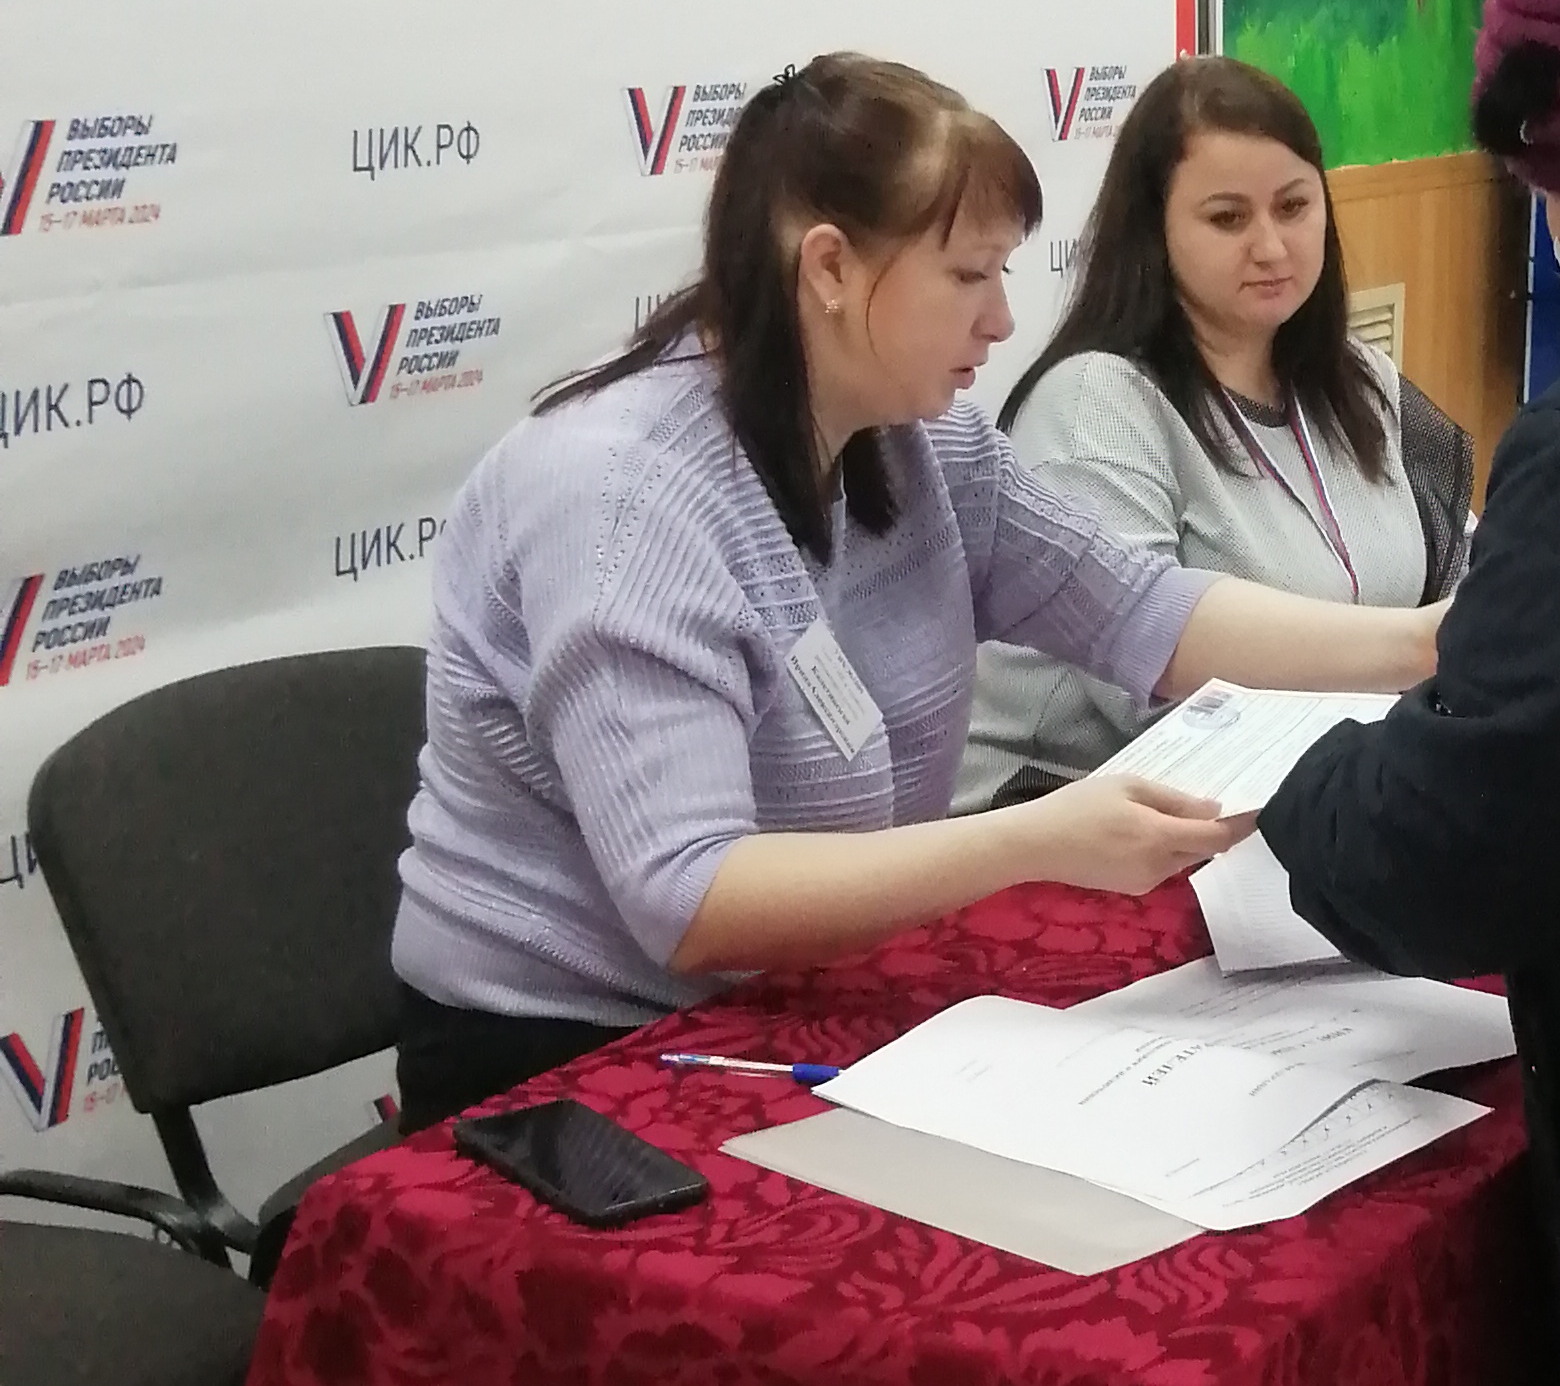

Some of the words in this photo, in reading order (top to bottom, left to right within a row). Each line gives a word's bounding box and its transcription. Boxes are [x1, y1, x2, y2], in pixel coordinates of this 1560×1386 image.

[1089, 65, 1127, 81] ВЫБОРЫ
[693, 83, 747, 102] ВЫБОРЫ
[1084, 85, 1136, 102] ПРЕЗИДЕНТА
[66, 114, 153, 140] ВЫБОРЫ
[1079, 106, 1113, 121] РОССИИ
[57, 143, 177, 172] ПРЕЗИДЕНТА
[350, 120, 482, 182] ЦИК.РФ
[46, 177, 126, 204] РОССИИ
[414, 294, 483, 321] ВЫБОРЫ
[406, 318, 501, 348] ПРЕЗИДЕНТА
[397, 350, 459, 376] РОССИИ
[336, 517, 447, 582] ЦИК.Р
[53, 554, 140, 590] ВЫБОРЫ
[42, 577, 162, 622] ПРЕЗИДЕНТА
[32, 616, 110, 652] РОССИИ
